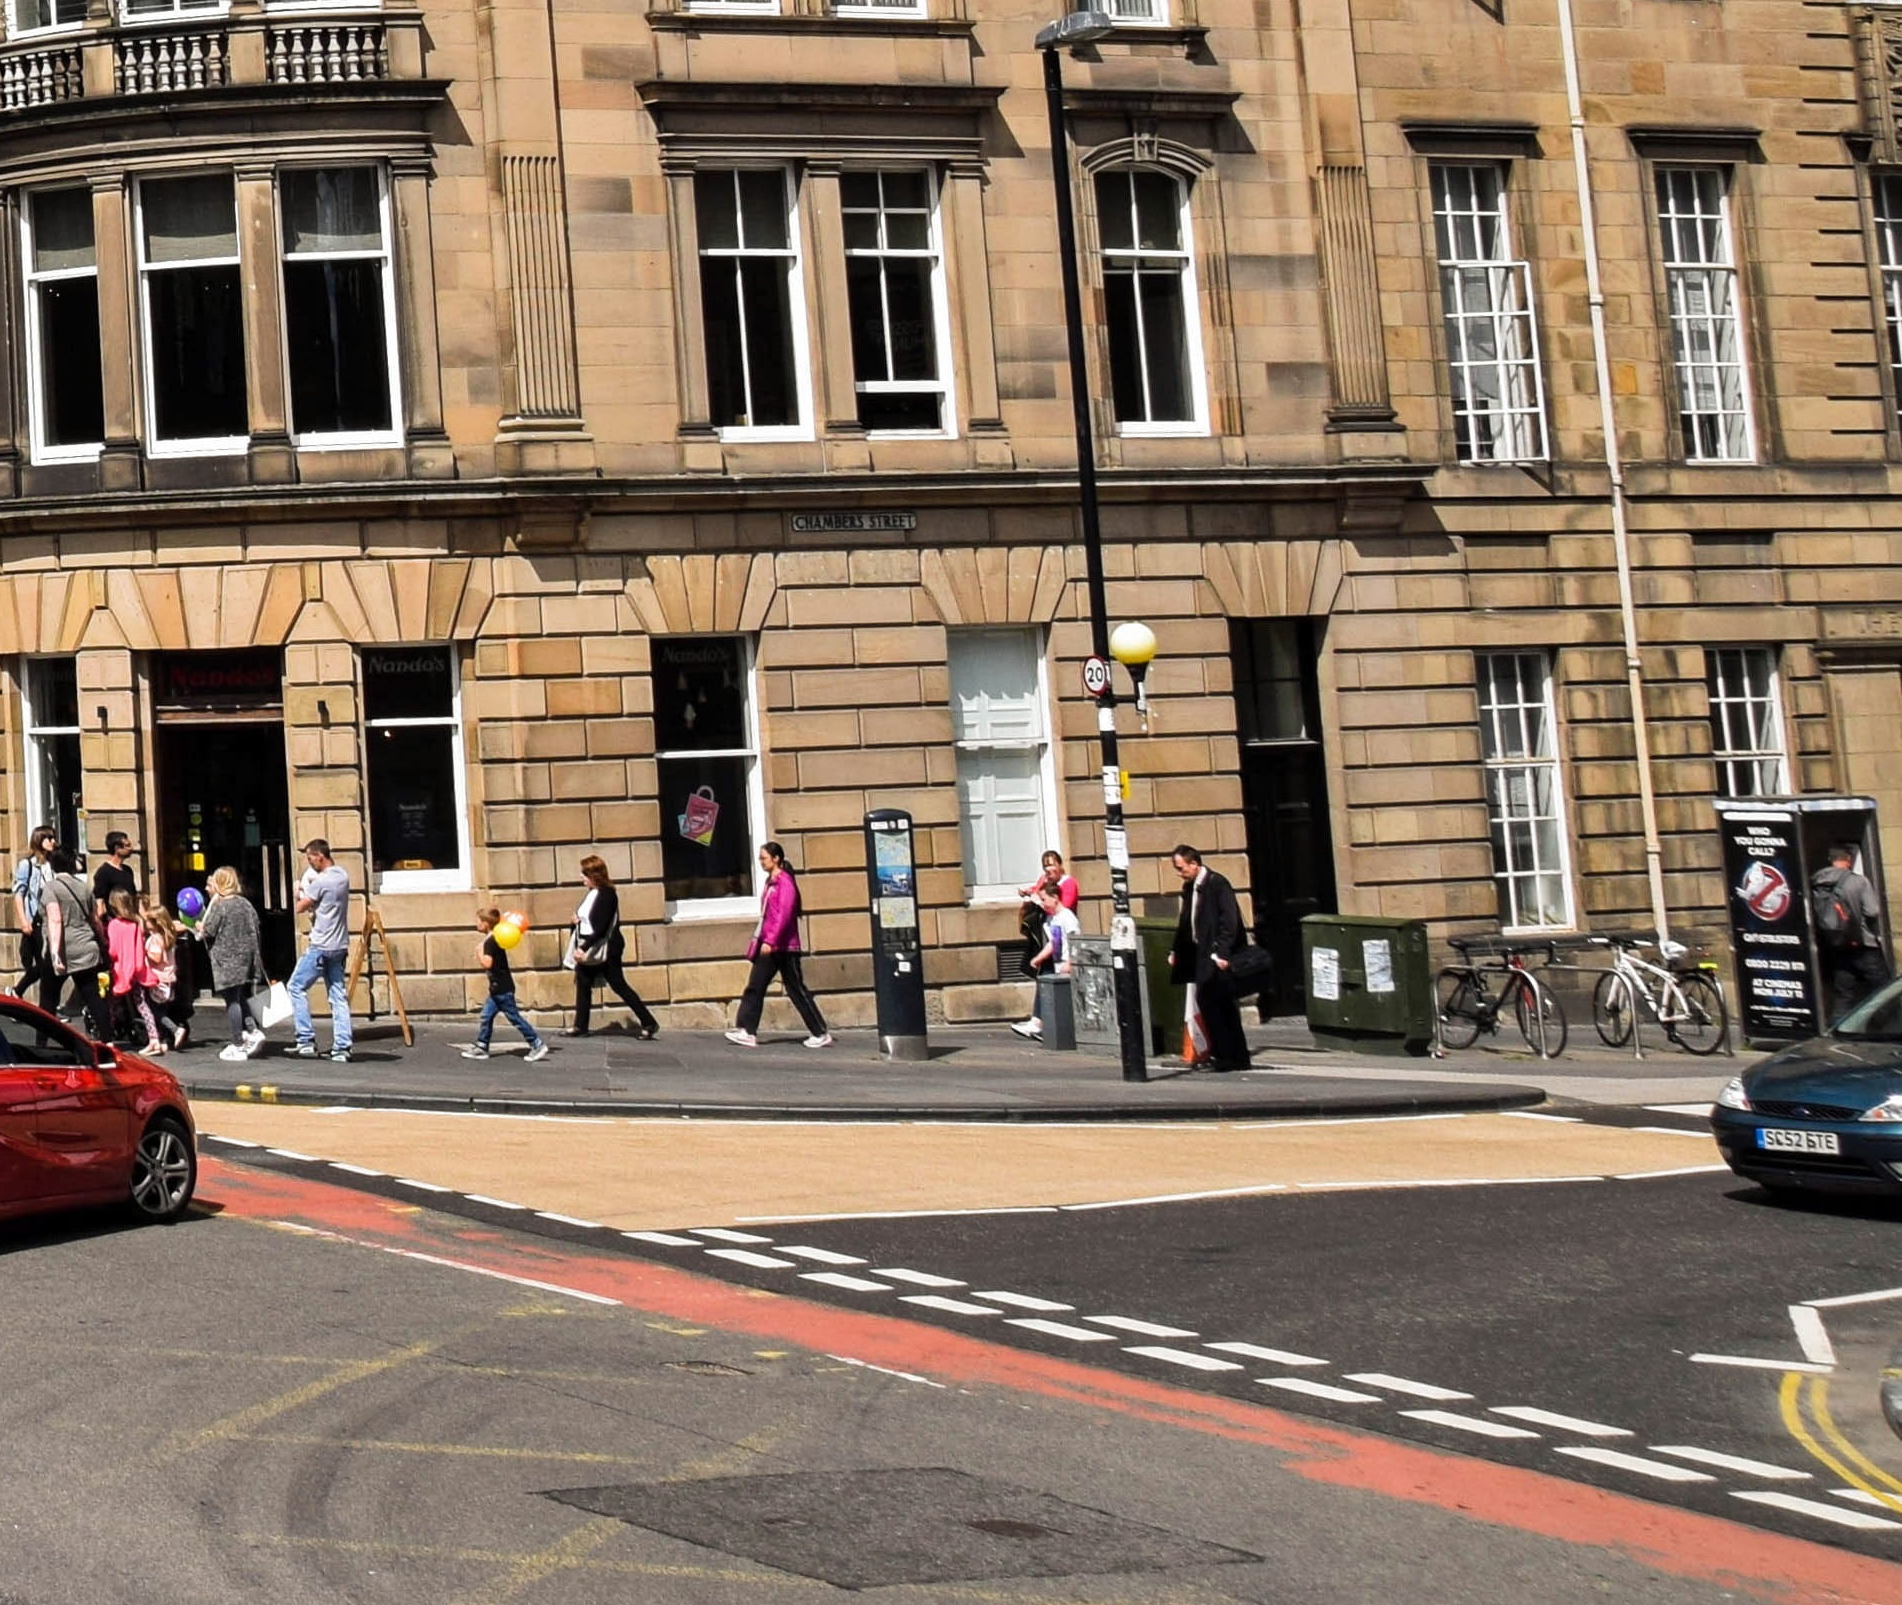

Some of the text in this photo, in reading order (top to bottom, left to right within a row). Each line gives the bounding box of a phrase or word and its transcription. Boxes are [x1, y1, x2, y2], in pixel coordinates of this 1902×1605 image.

[795, 515, 913, 529] CHAMBERS STREET
[369, 654, 445, 674] Nando's
[1086, 666, 1103, 683] 20
[1733, 836, 1787, 847] YOU GONNA
[1748, 847, 1776, 856] CALL?
[1765, 1130, 1803, 1148] SC52
